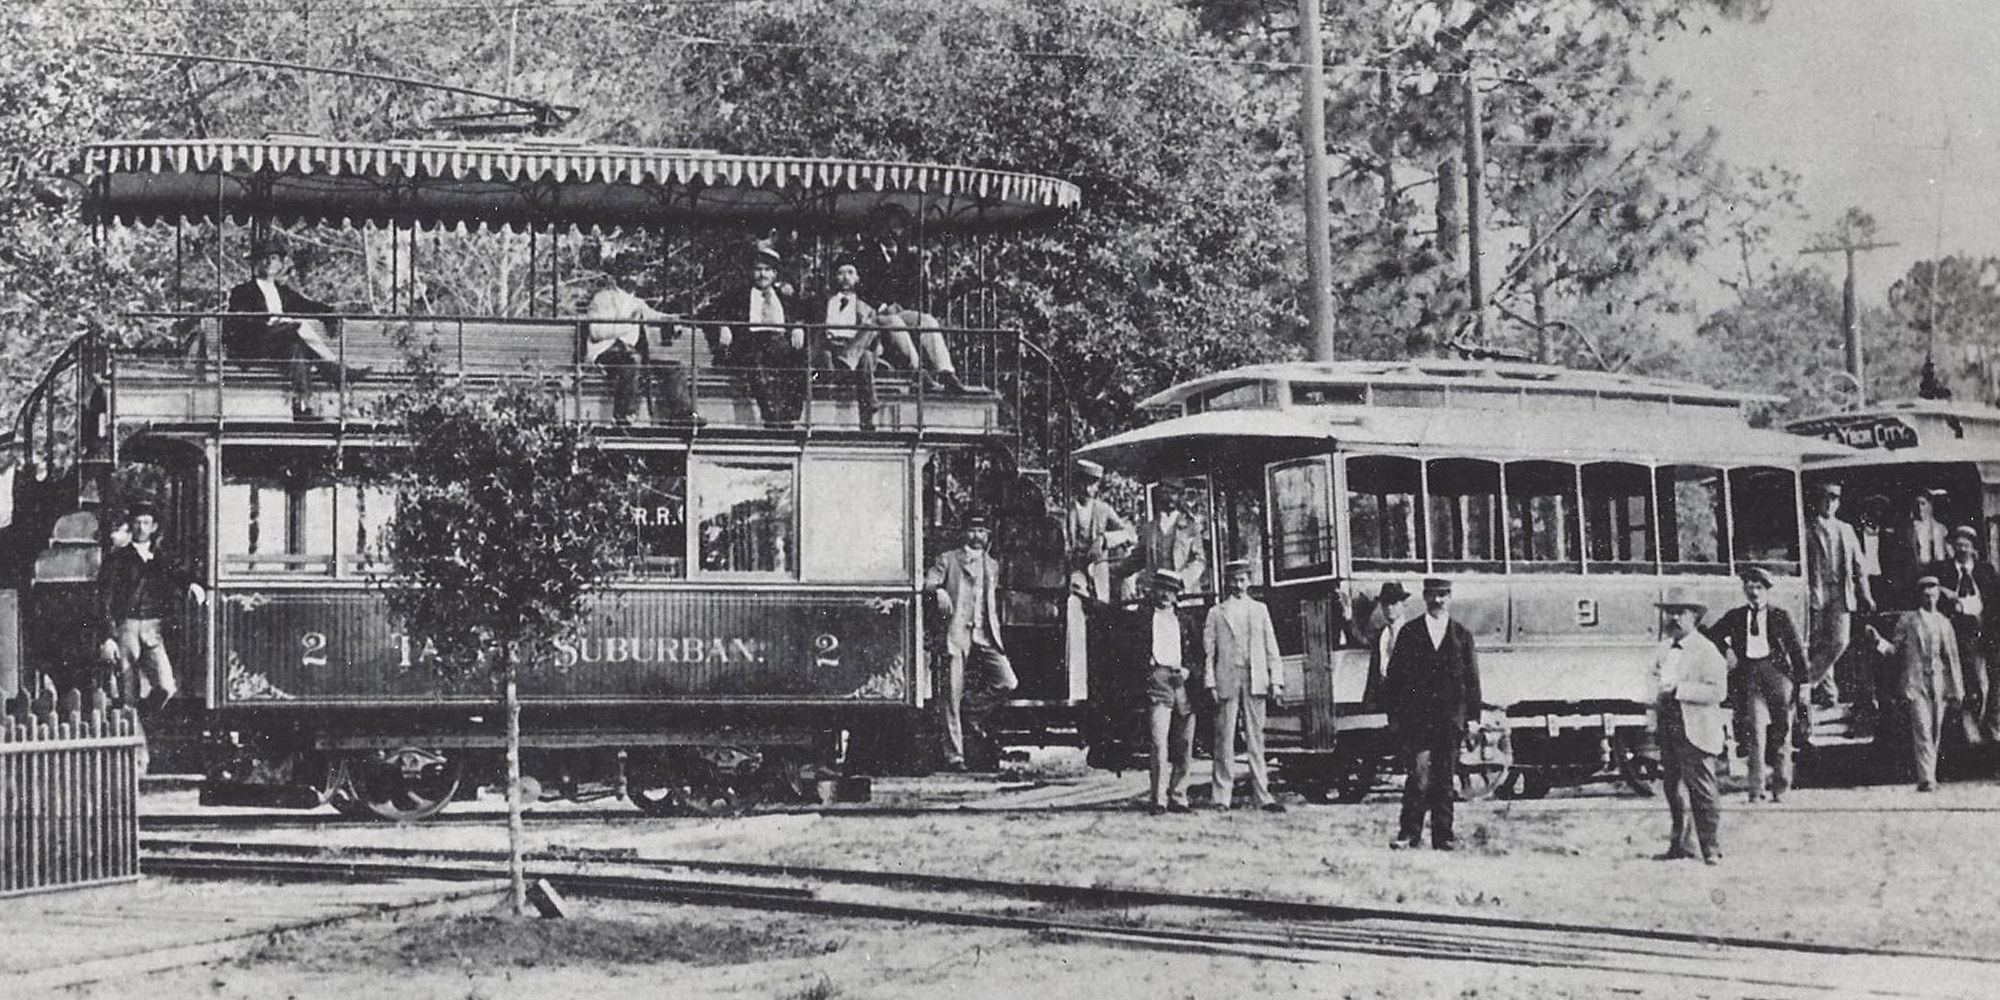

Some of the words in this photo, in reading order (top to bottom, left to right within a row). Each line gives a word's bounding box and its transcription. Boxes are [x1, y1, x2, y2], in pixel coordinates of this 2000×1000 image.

[1576, 598, 1599, 628] 9
[301, 631, 327, 665] 2
[815, 633, 840, 667] 2
